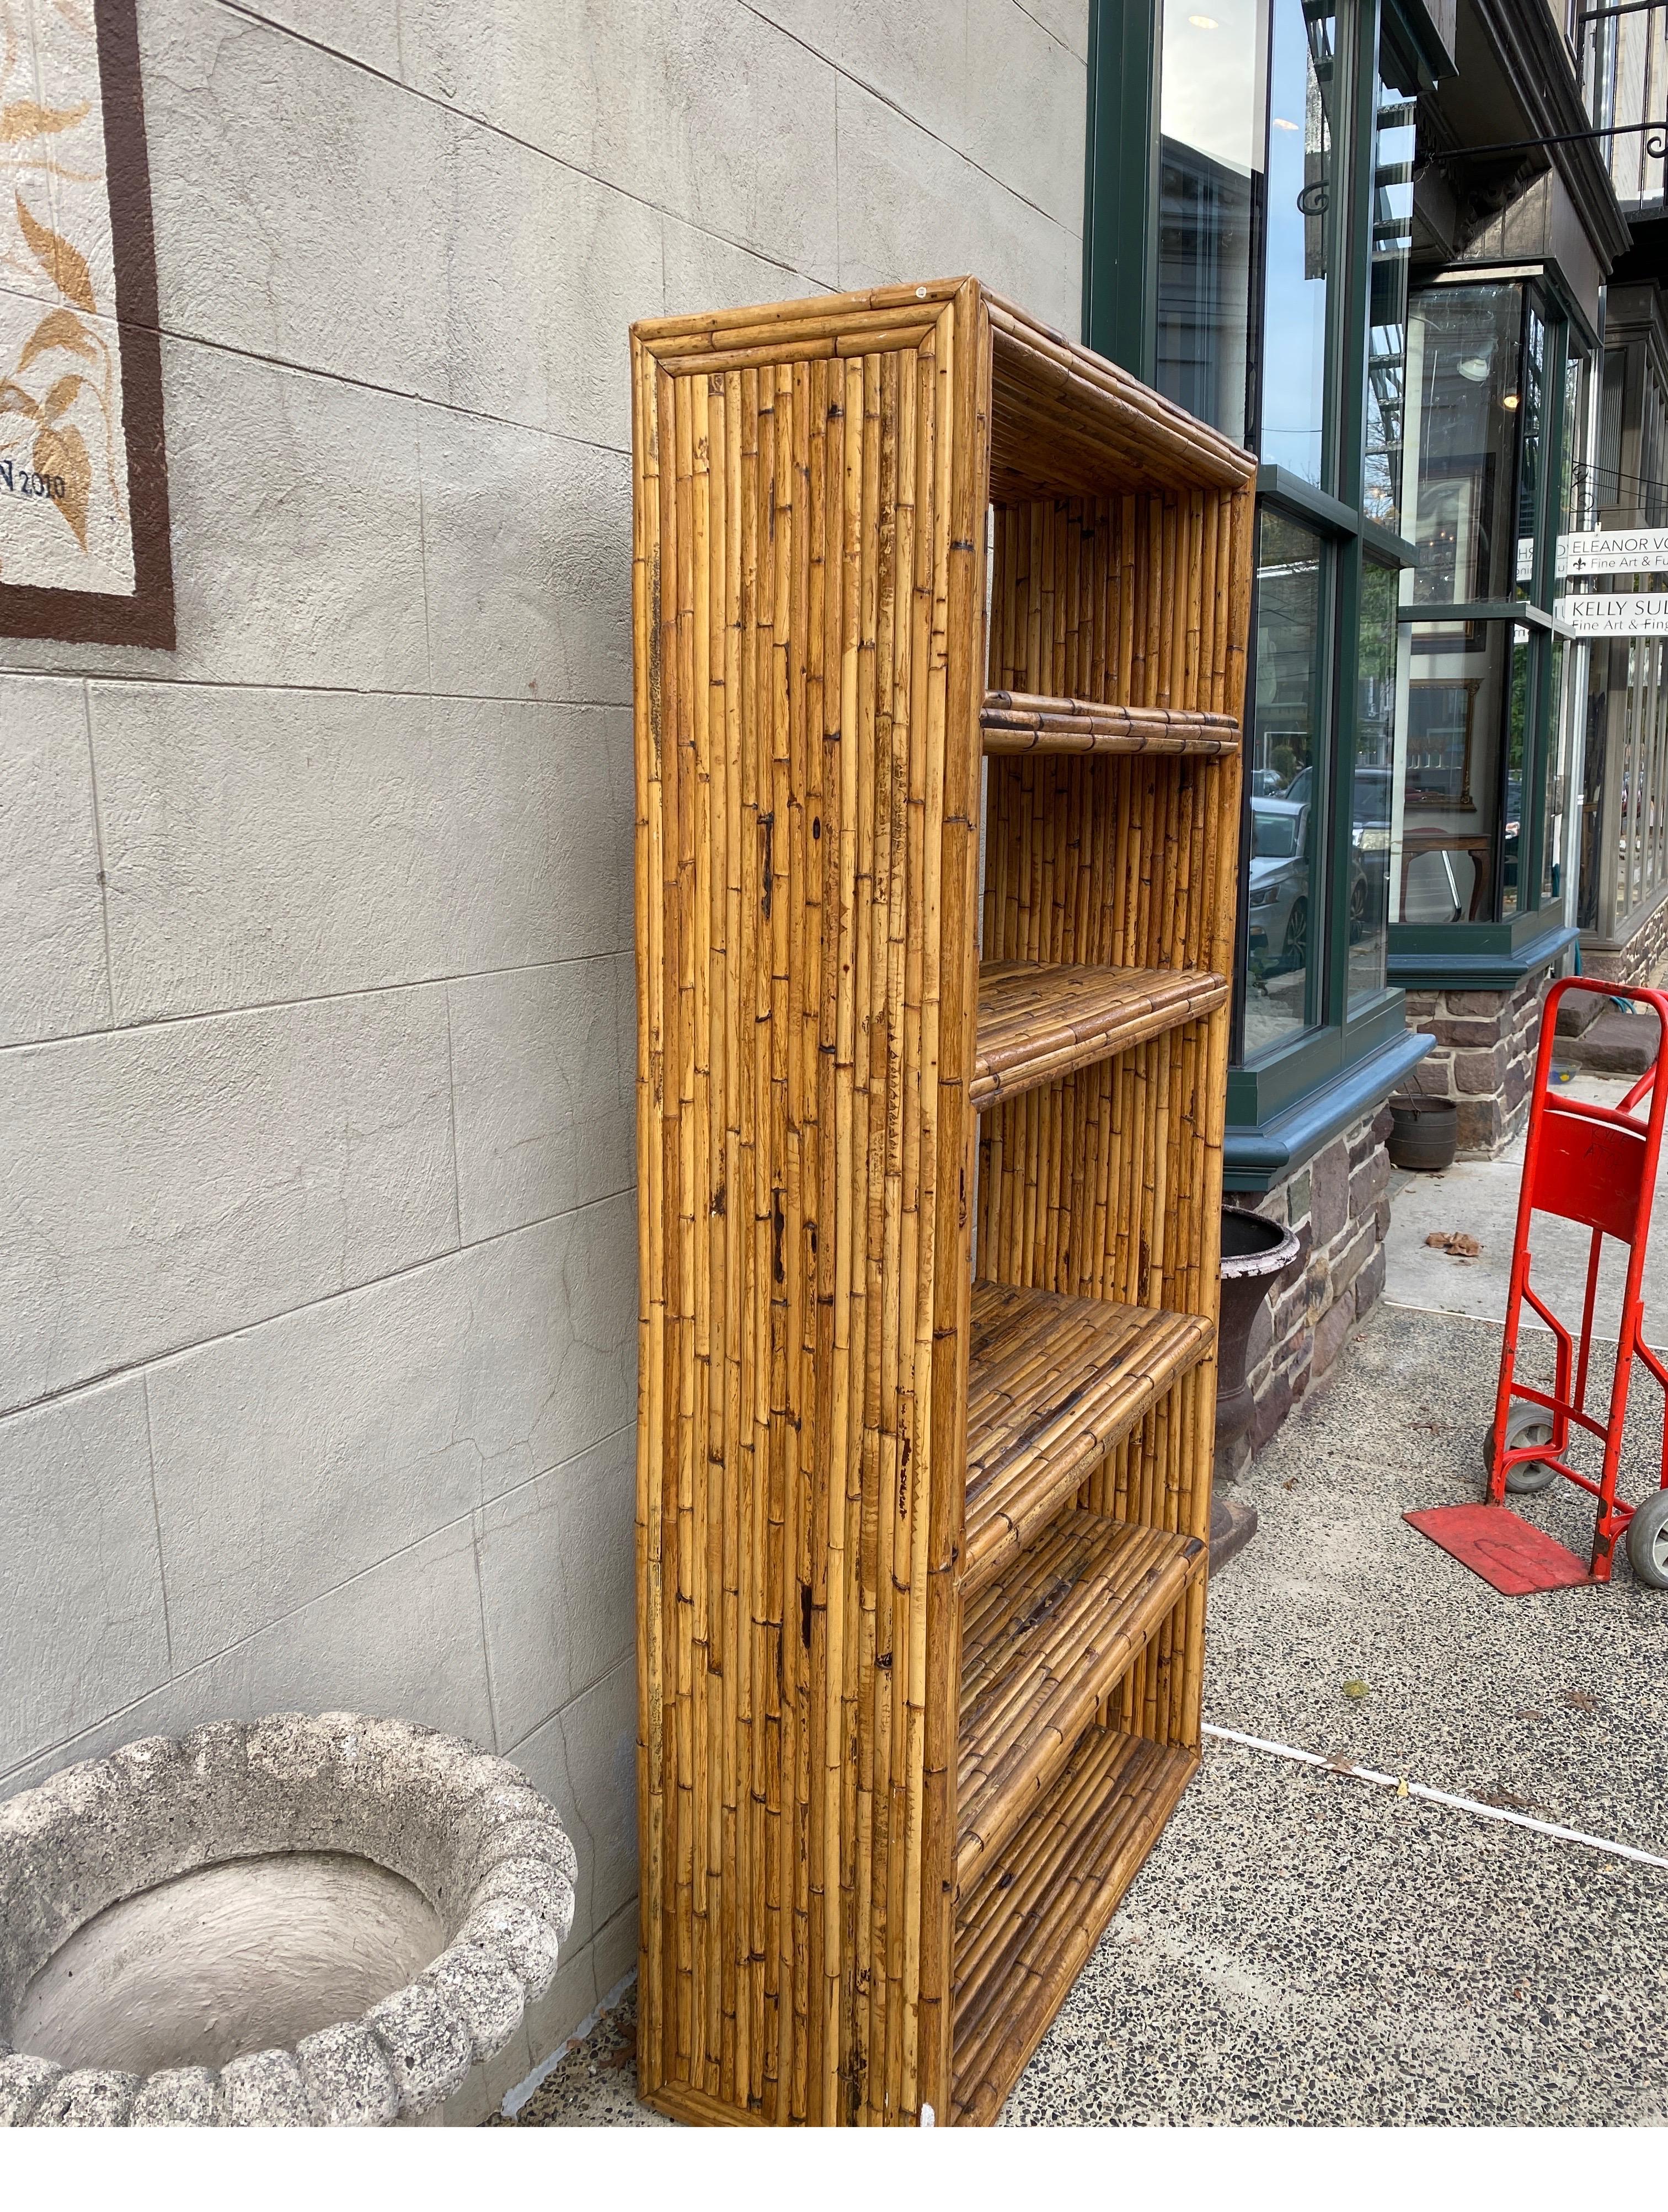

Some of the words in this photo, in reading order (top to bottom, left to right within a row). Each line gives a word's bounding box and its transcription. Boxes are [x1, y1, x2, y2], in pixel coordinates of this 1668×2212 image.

[19, 470, 66, 499] 2010
[1573, 538, 1648, 553] ELEANOR
[1591, 558, 1616, 569] Fine
[1619, 557, 1638, 567] Art
[1642, 556, 1650, 566] &
[1573, 601, 1628, 616] KELLY
[1572, 619, 1599, 630] Fine
[1604, 619, 1623, 630] Art
[1628, 619, 1638, 630] &
